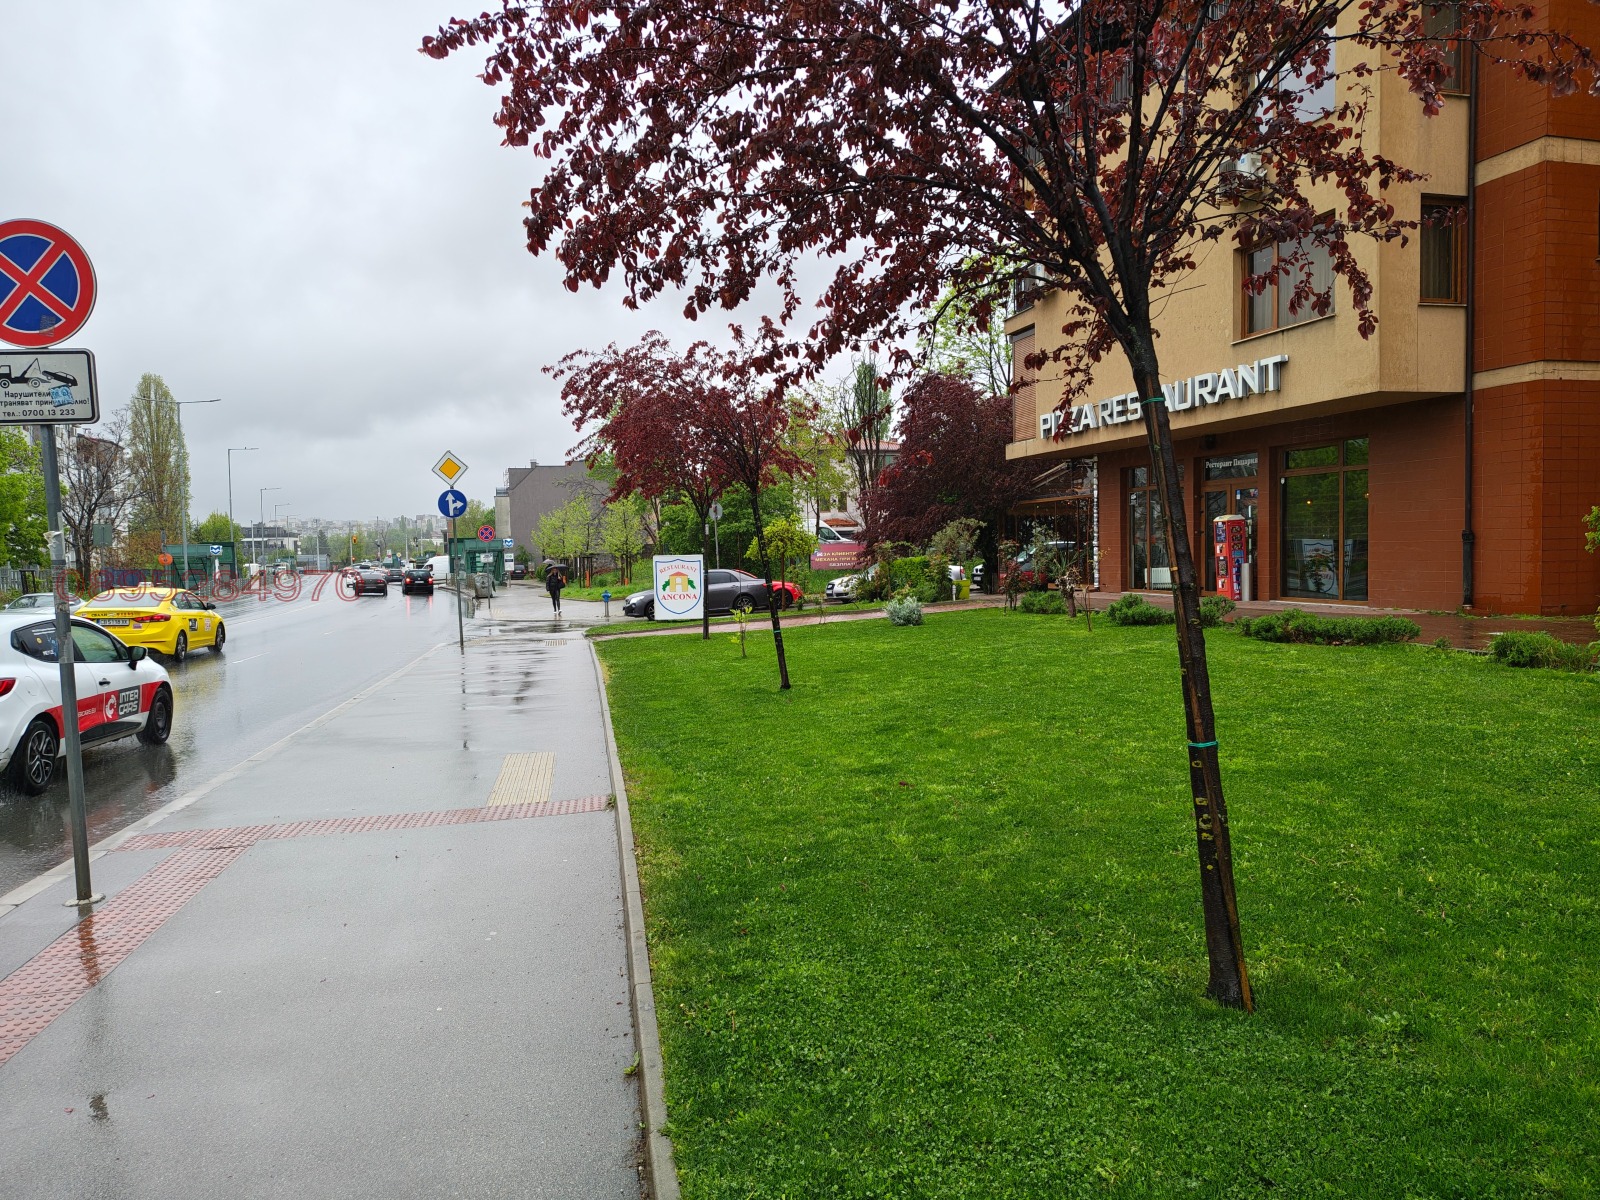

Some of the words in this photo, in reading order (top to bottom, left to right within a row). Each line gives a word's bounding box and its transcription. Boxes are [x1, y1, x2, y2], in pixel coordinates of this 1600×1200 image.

[4, 391, 55, 399] Нарушители
[1098, 354, 1289, 427] RESAURANT
[0, 400, 33, 408] траняват
[22, 409, 44, 417] 0700
[59, 408, 76, 416] 233
[659, 564, 697, 574] RESTAURANT
[661, 593, 697, 601] ANCONA
[120, 690, 138, 702] INTER
[119, 701, 138, 715] CARS
